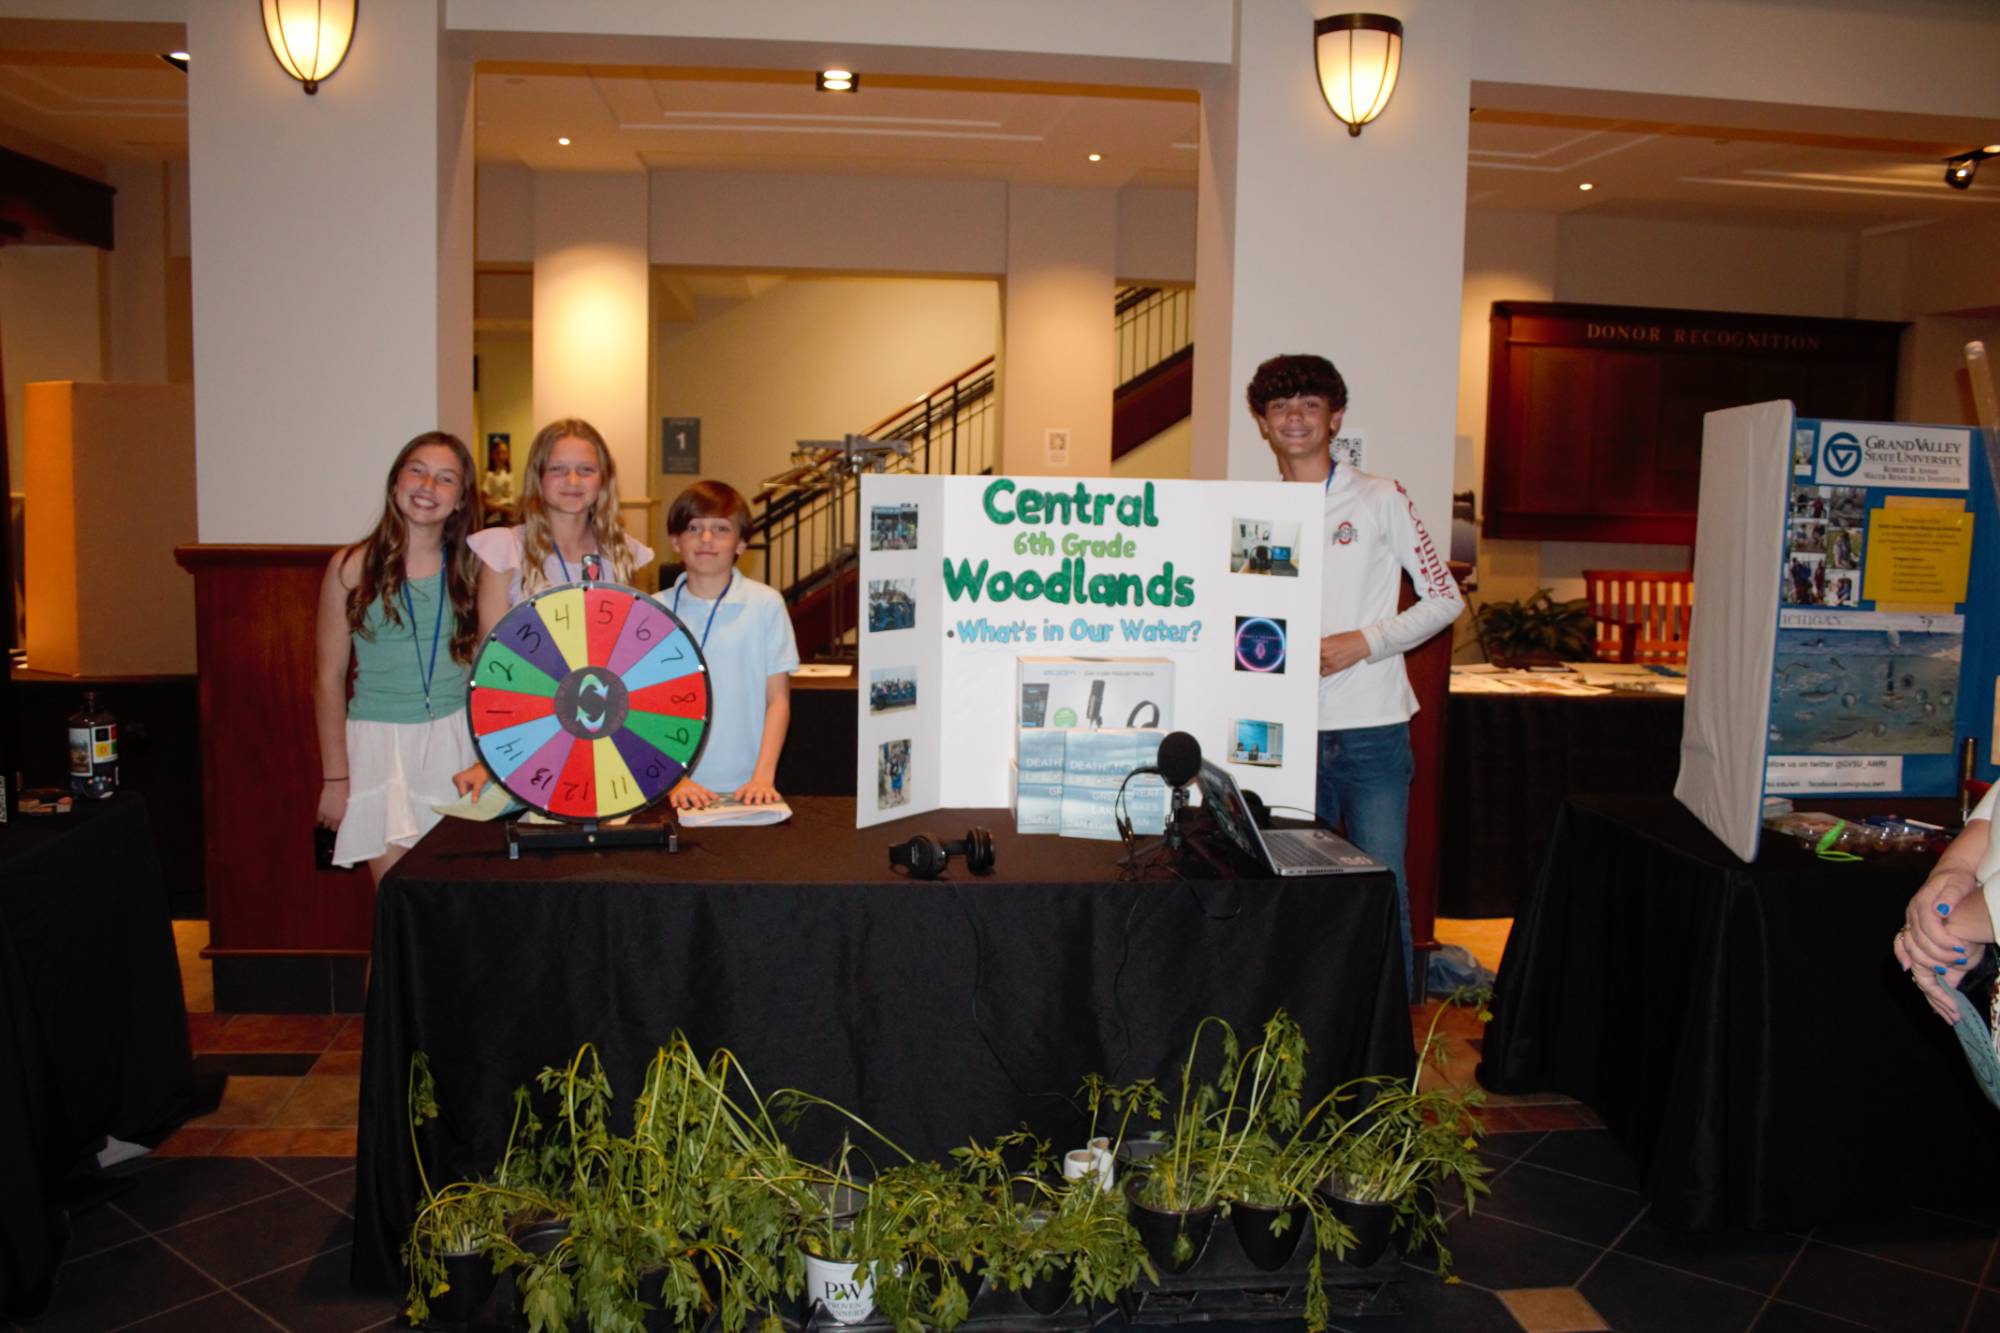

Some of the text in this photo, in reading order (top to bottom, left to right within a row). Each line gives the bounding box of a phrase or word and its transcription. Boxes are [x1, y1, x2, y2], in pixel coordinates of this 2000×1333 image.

[1587, 323, 1821, 349] DONOR RECOGNITION
[675, 432, 686, 450] 1
[1865, 435, 1962, 453] GRAND VALLEY
[1864, 451, 1896, 463] STATE
[983, 479, 1159, 527] Central
[1013, 531, 1136, 558] 6th Grade
[943, 557, 1195, 607] Woodlands
[555, 603, 572, 630] 4
[598, 600, 615, 625] 5
[1783, 614, 1841, 625] ICHIGAN
[516, 623, 542, 654] 3
[635, 617, 652, 641] 6
[957, 617, 1202, 643] What's in Our Water?
[661, 647, 684, 664] 7
[489, 660, 515, 682] 2
[670, 692, 697, 705] 8
[665, 727, 690, 745] 9
[496, 738, 523, 761] 14
[646, 758, 668, 779] 10
[1026, 758, 1062, 768] DEATH
[530, 768, 554, 790] 13
[611, 776, 628, 799] 11
[563, 781, 589, 801] 12
